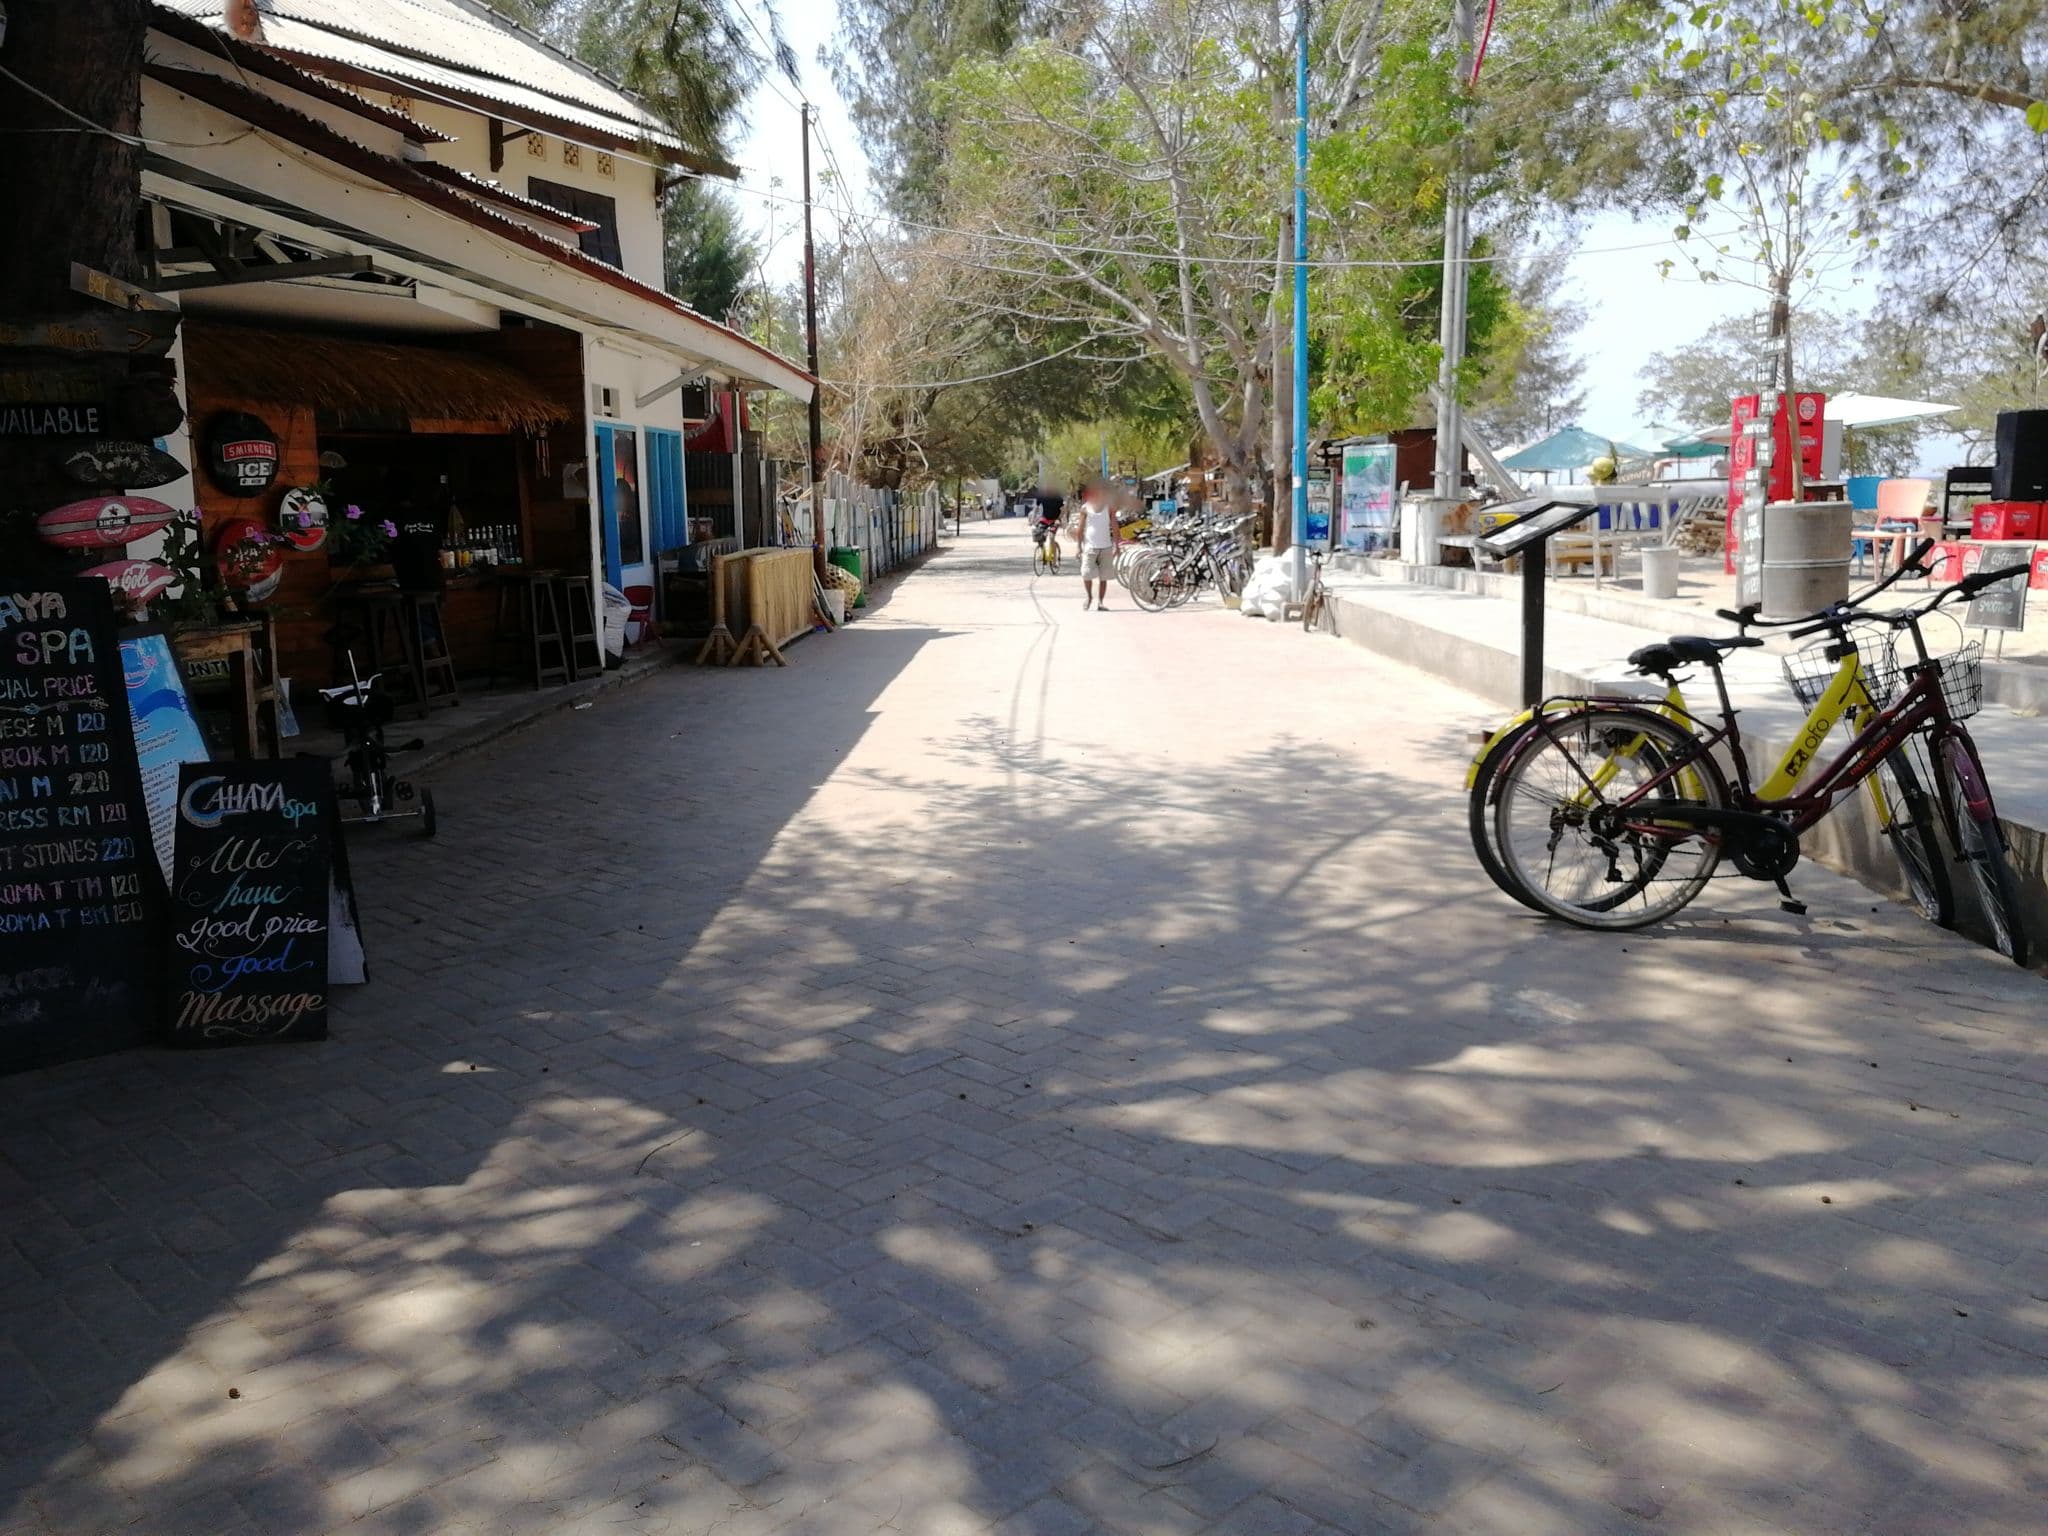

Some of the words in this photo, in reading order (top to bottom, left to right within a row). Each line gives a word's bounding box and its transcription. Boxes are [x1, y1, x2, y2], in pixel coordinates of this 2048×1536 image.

[237, 462, 272, 477] ICE
[16, 628, 95, 666] SPA
[43, 675, 97, 698] PRICE
[47, 714, 65, 736] M
[76, 712, 106, 733] 120
[1805, 718, 1829, 749] ofo
[52, 744, 70, 766] M
[80, 741, 109, 764] 120
[32, 775, 53, 798] M
[68, 769, 111, 795] 220
[57, 805, 91, 827] RM
[100, 802, 128, 824] 120
[180, 776, 284, 828] CAHAYA
[282, 798, 318, 829] spa
[23, 838, 99, 868] STONES
[101, 837, 136, 862] 220
[50, 880, 65, 900] T
[110, 873, 140, 900] 120
[213, 871, 298, 914] have
[52, 907, 72, 928] T
[176, 905, 261, 954] good
[260, 914, 327, 945] price
[176, 991, 327, 1033] Massage
